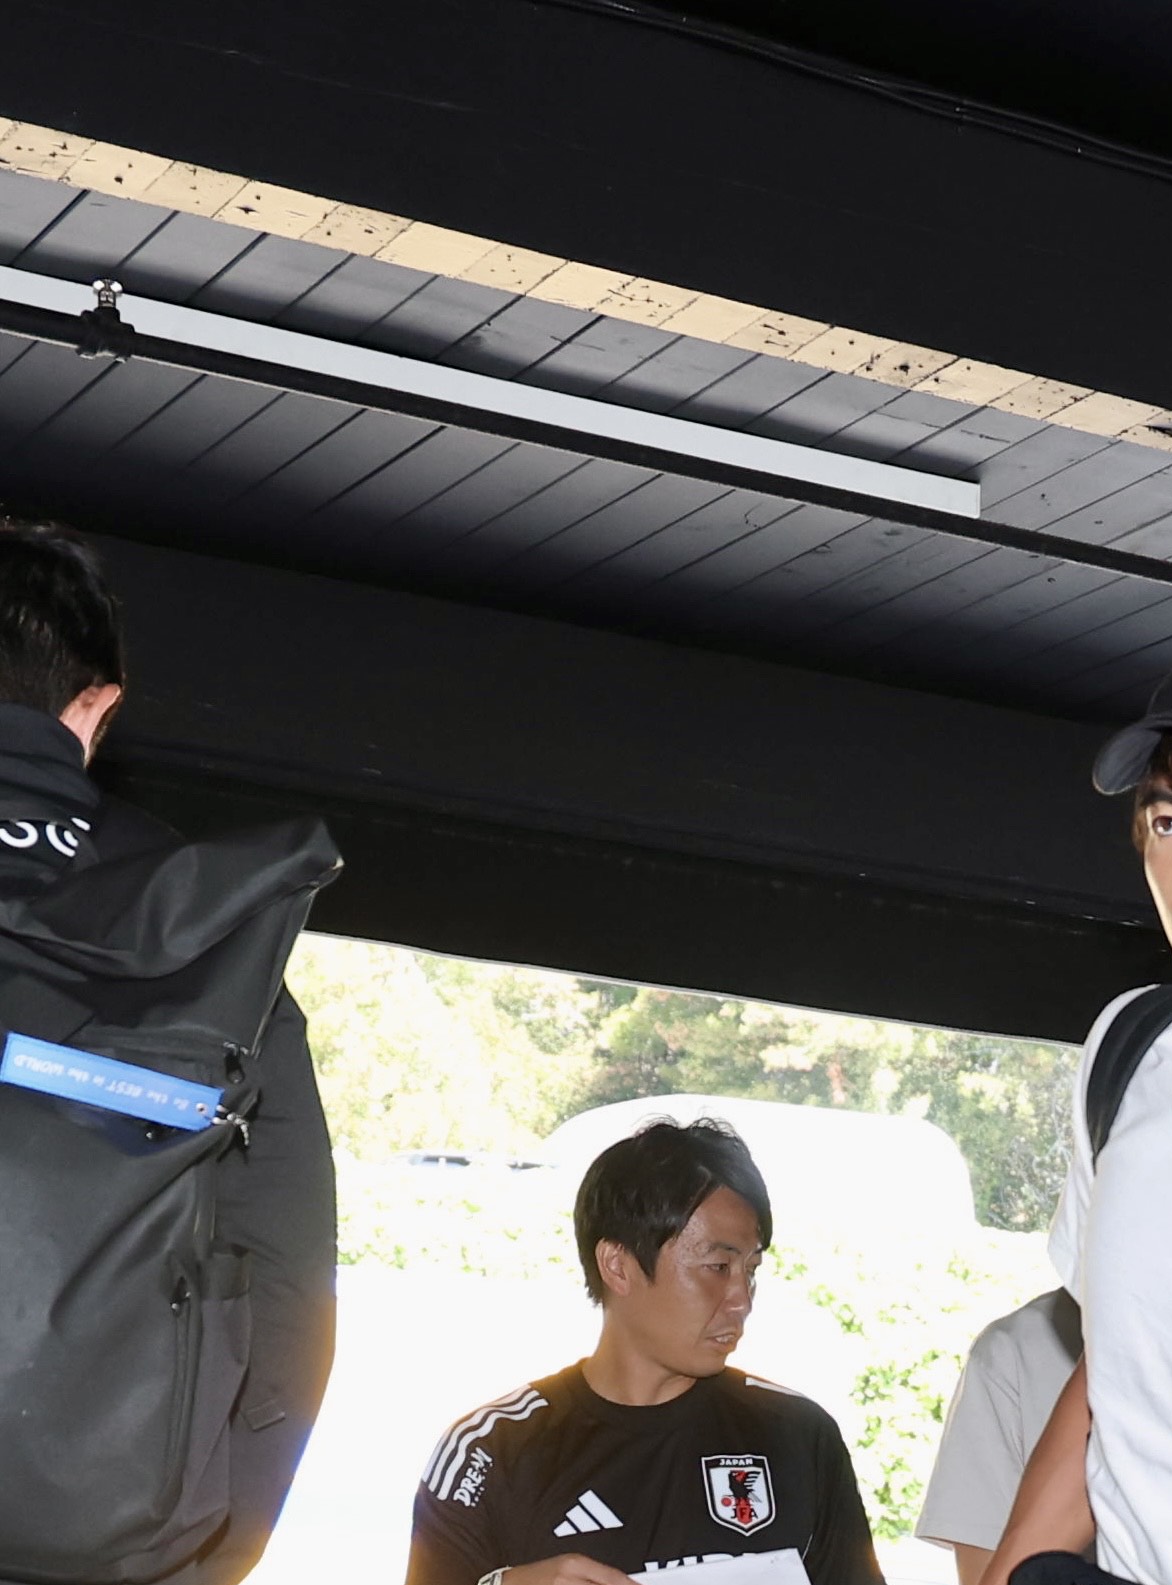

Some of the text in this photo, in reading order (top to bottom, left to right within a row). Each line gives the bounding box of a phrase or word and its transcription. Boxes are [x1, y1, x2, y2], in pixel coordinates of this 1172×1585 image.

[13, 1054, 65, 1076] WORLD
[67, 1066, 90, 1083] the
[105, 1079, 143, 1098] BEST
[147, 1091, 168, 1105] the
[719, 1458, 754, 1466] JAPAN
[730, 1506, 759, 1520] JFA
